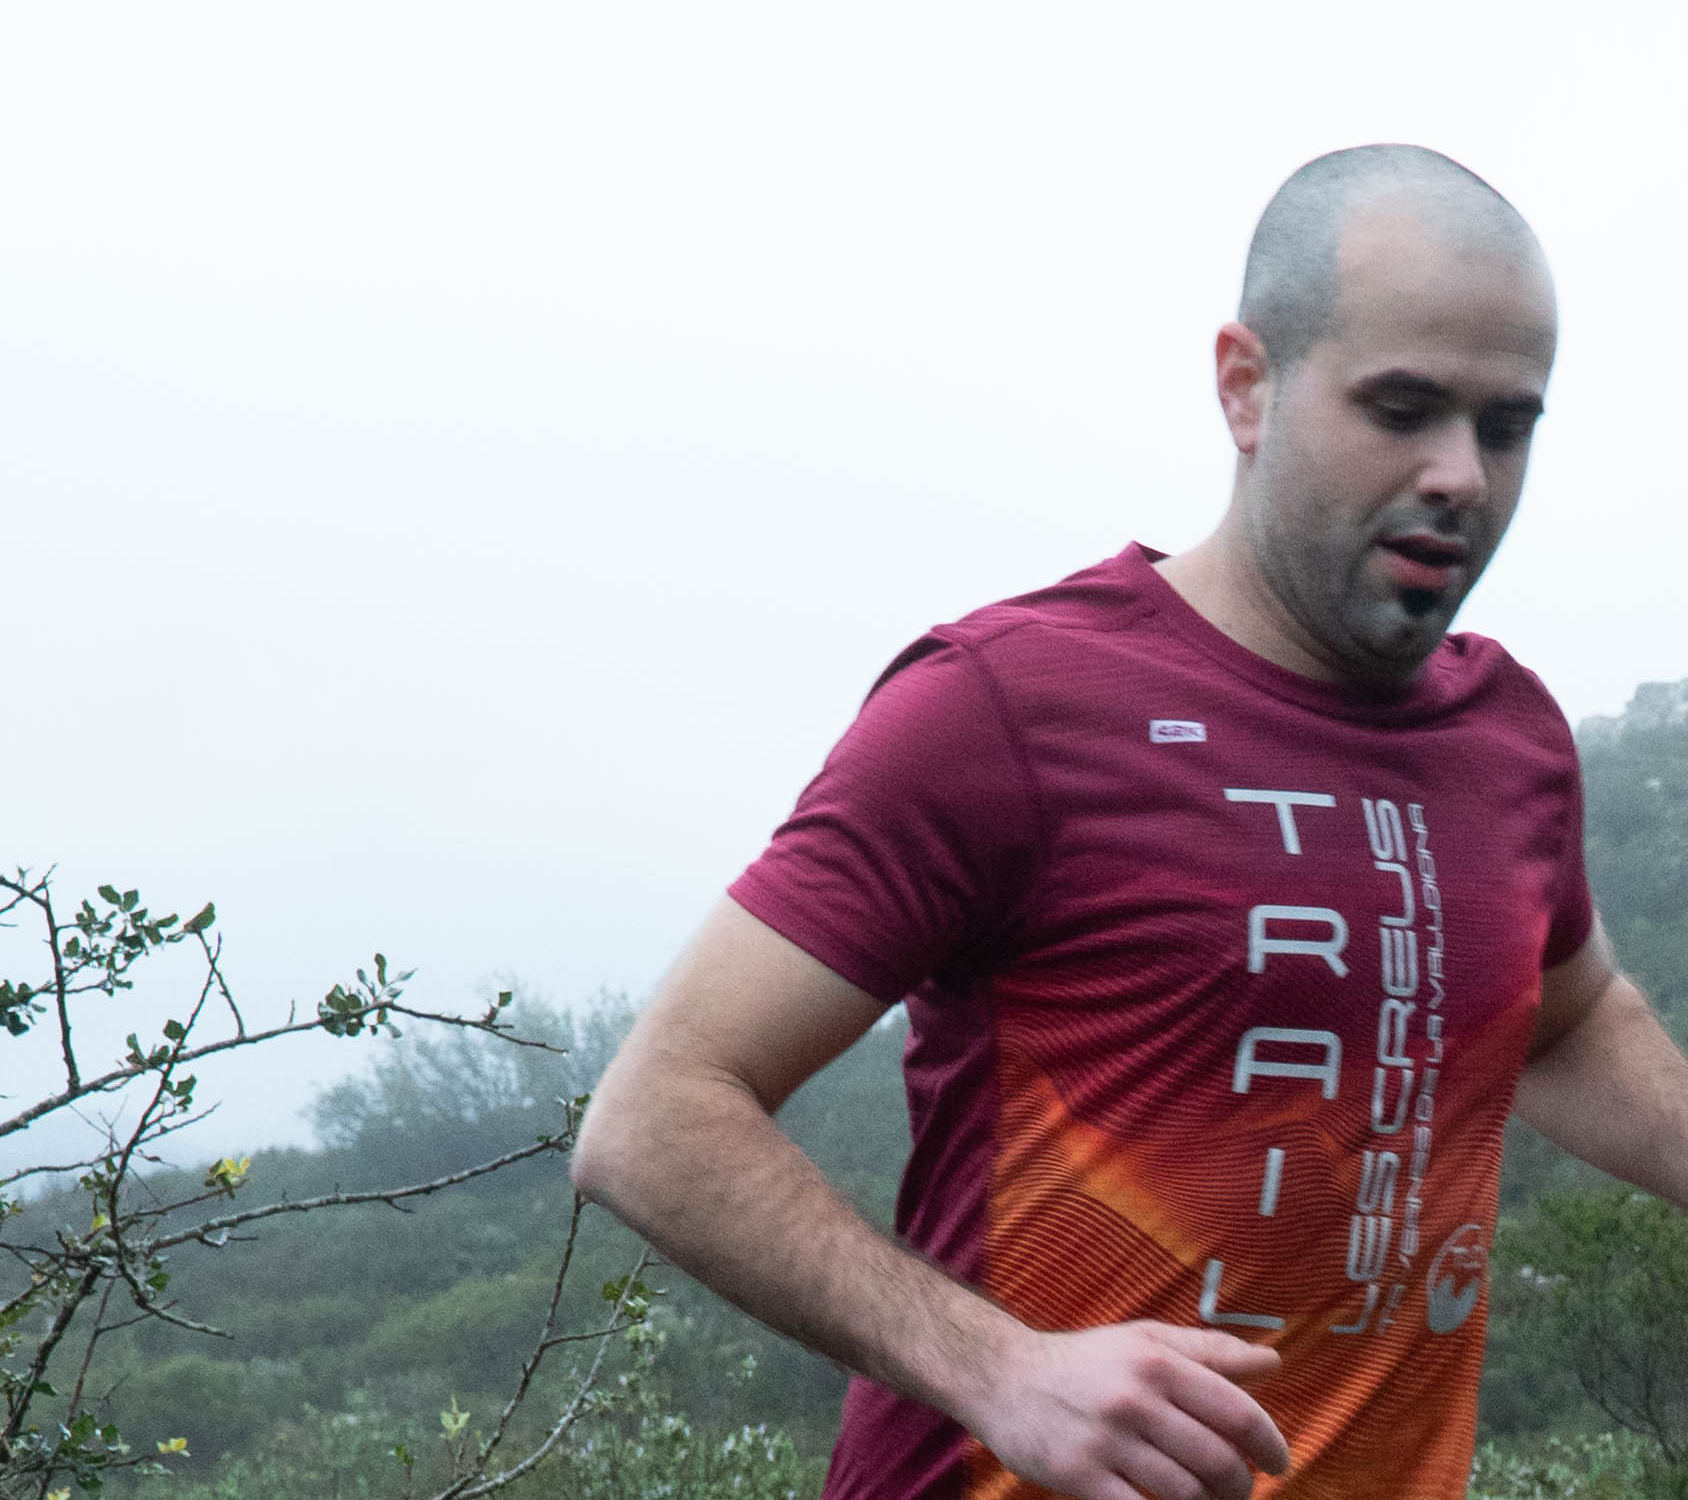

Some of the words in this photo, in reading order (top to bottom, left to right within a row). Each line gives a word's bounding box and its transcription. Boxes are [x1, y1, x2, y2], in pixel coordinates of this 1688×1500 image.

[1198, 787, 1350, 1330] TRAIL
[1361, 797, 1420, 1134] CREUS
[1425, 1014, 1445, 1063] LA
[1329, 1151, 1399, 1334] LES
